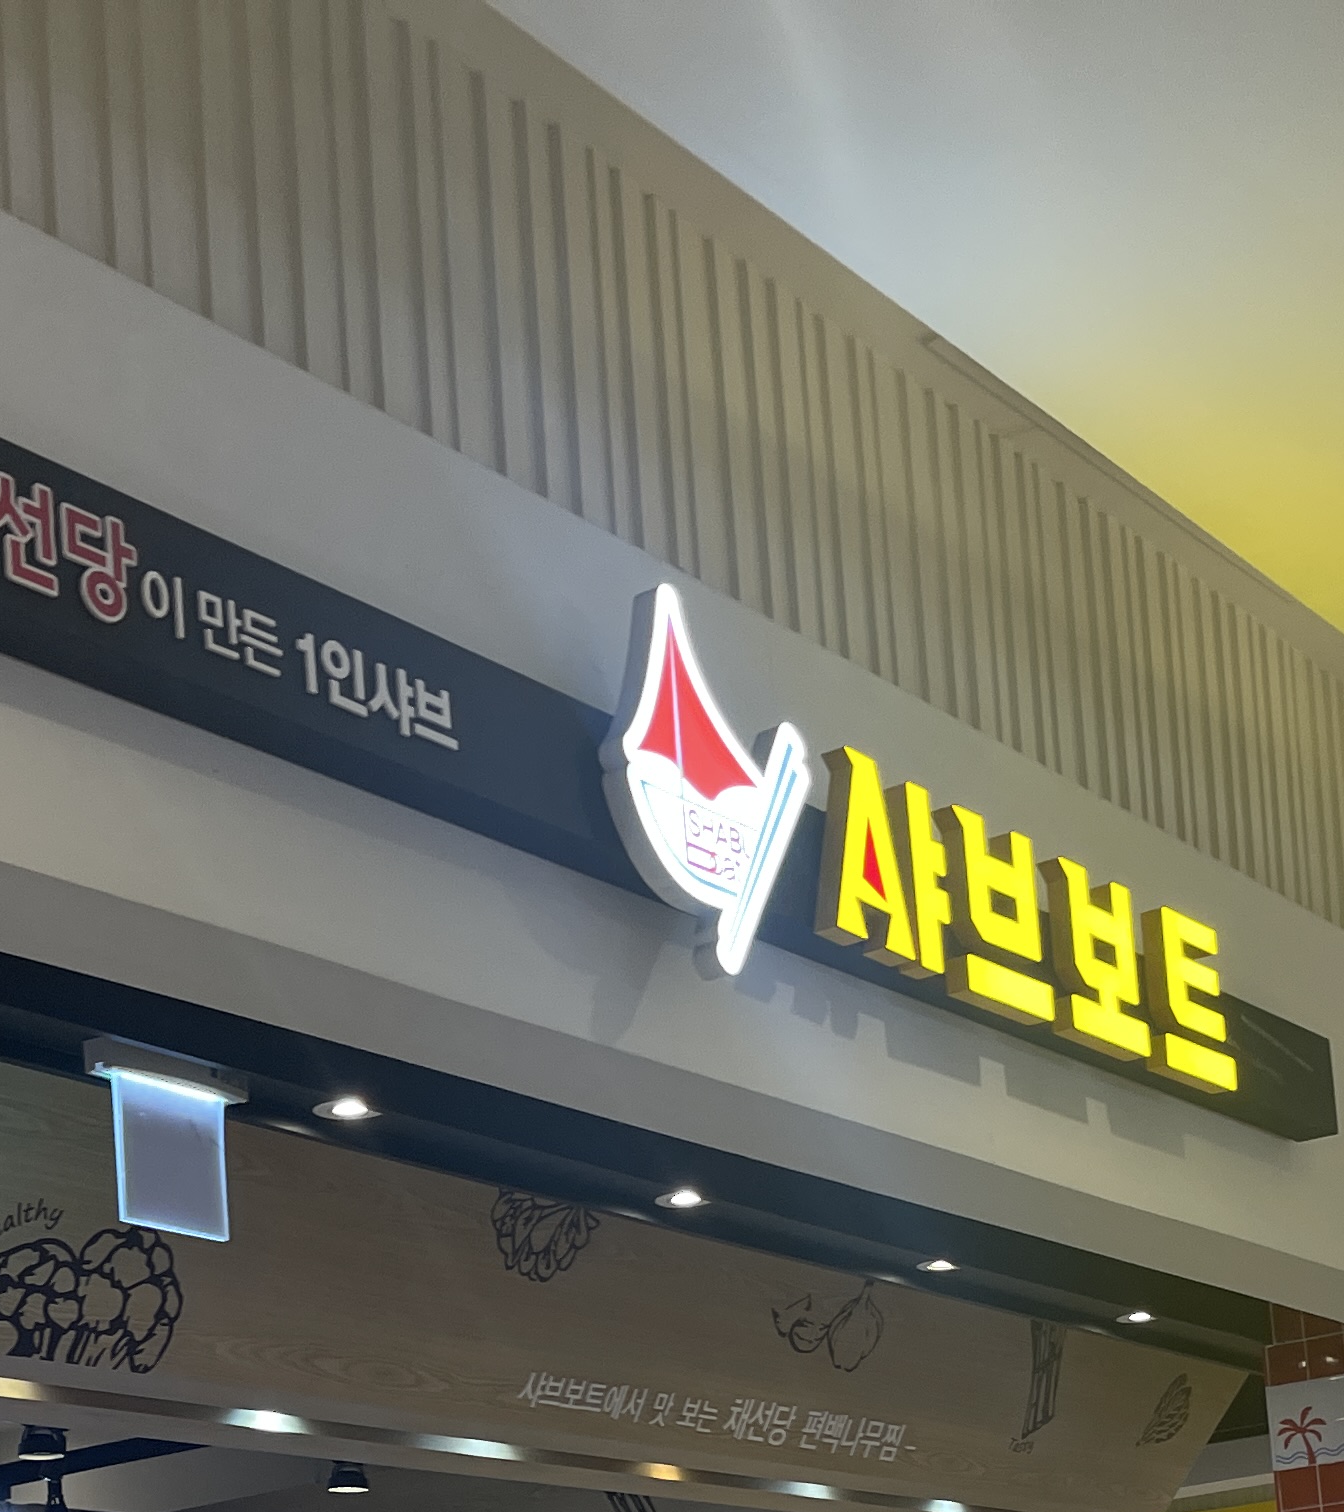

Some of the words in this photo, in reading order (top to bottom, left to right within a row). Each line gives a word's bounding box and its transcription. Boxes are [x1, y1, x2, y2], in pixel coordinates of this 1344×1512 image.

[196, 589, 283, 677] 만든
[296, 632, 460, 751] 1인샤브
[830, 745, 1238, 1093] 샤브보트
[517, 1371, 647, 1424] 샤브보트에서
[649, 1391, 676, 1427] 맛
[676, 1397, 718, 1433] 보는
[723, 1398, 798, 1447] 채선당
